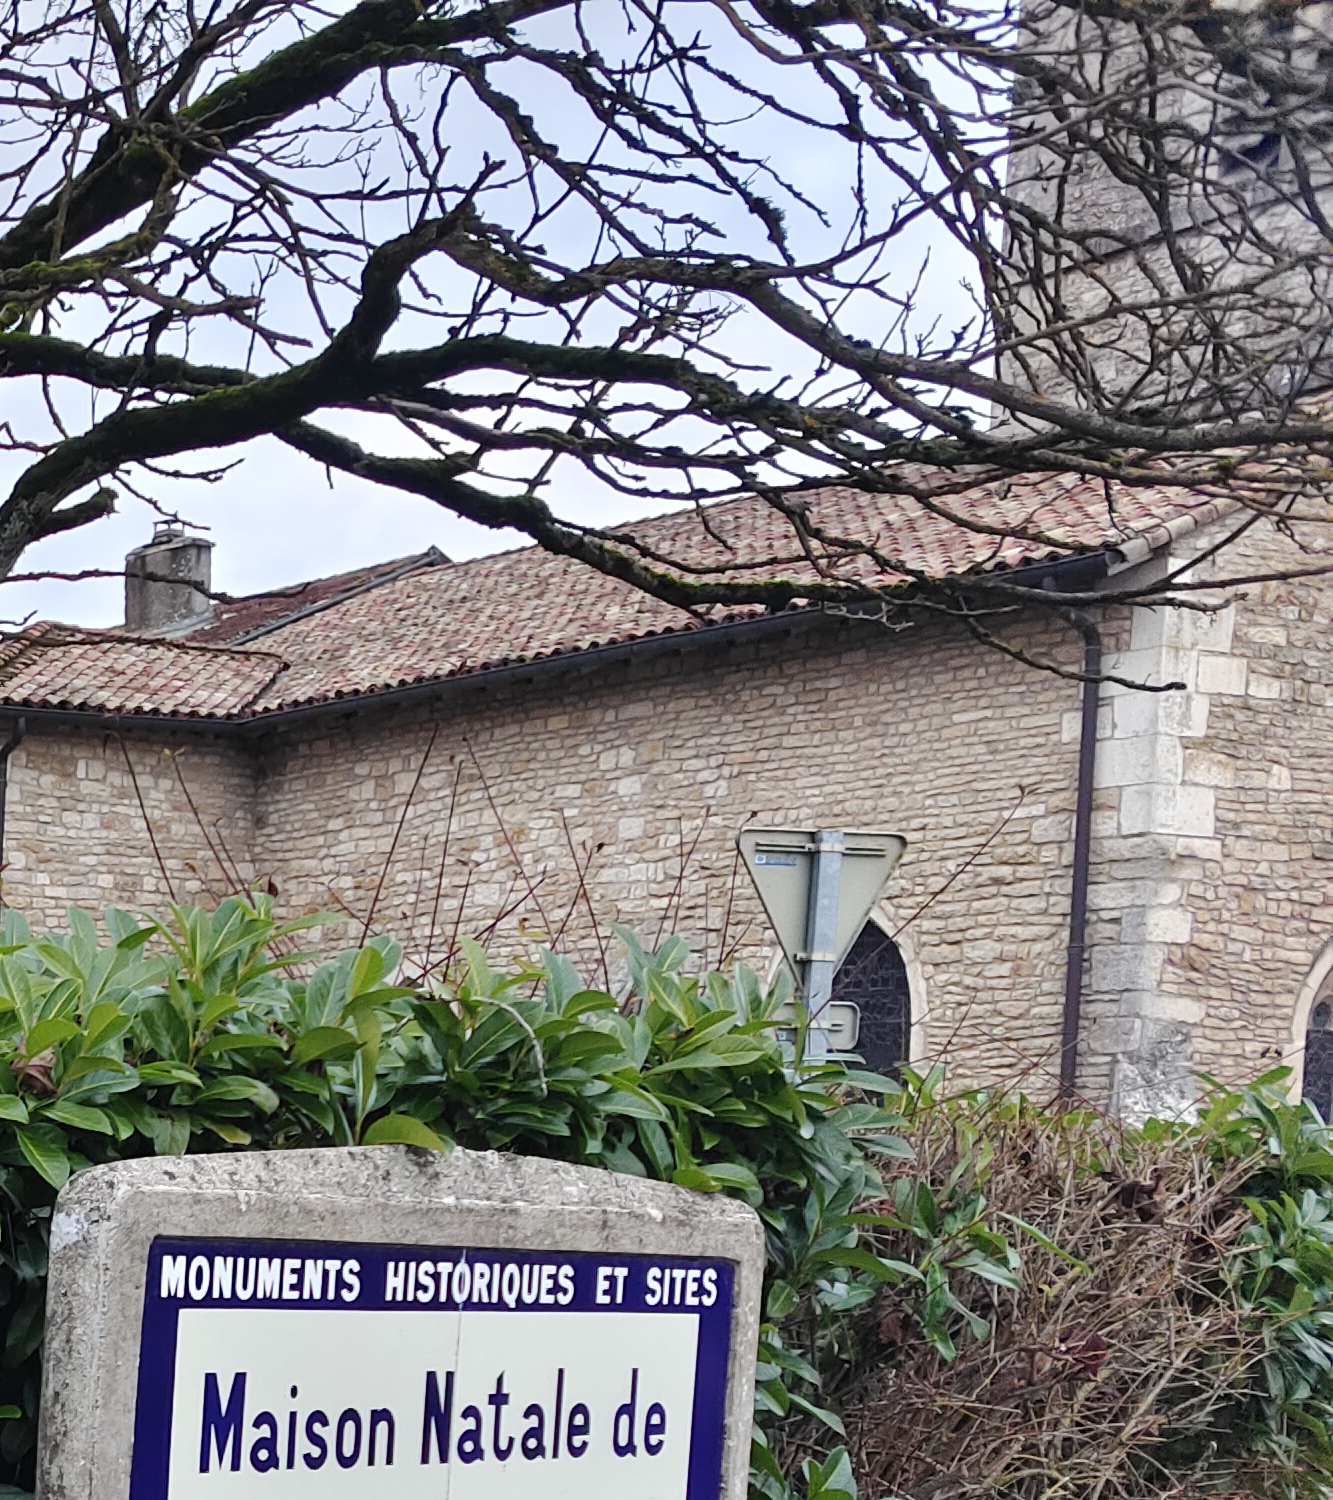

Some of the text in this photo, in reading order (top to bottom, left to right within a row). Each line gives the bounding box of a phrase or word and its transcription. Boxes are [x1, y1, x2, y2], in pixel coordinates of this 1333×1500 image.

[161, 1255, 718, 1308] MONUMENTS HISTORIQUES ET SITES
[199, 1367, 667, 1473] Maison Natale de
